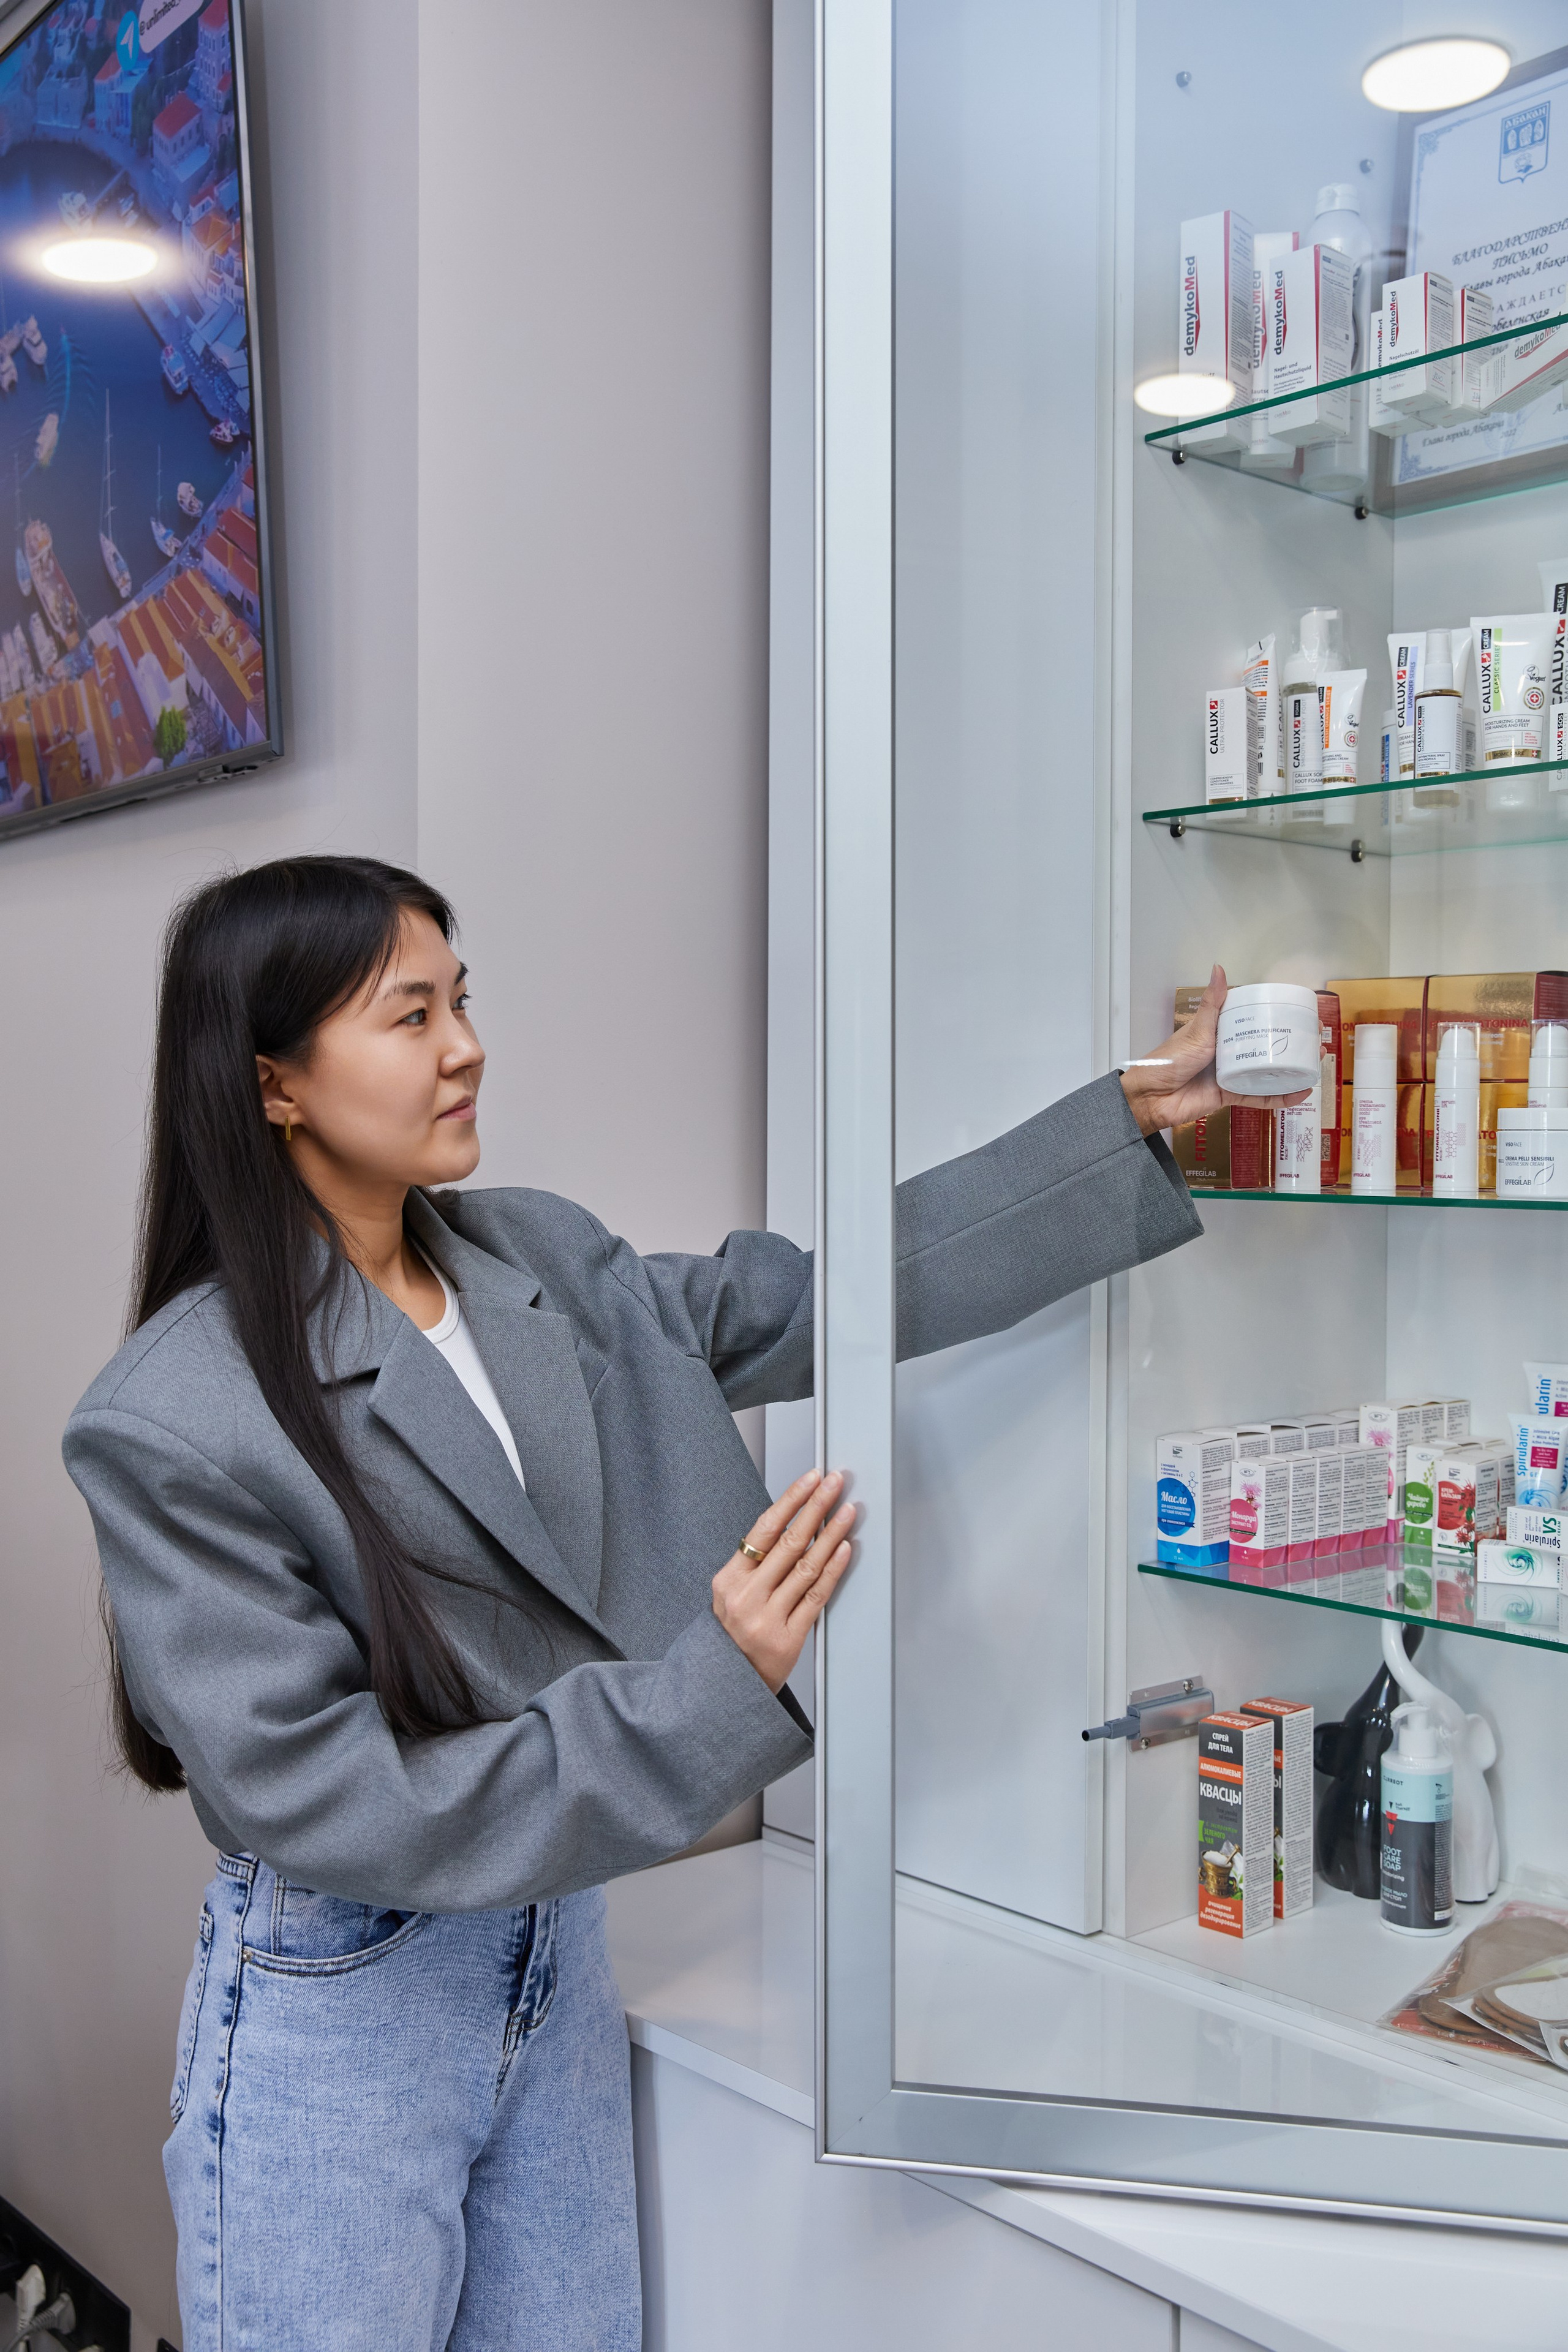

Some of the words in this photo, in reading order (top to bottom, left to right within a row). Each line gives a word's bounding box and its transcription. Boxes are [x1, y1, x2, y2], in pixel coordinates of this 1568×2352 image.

[1492, 243, 1548, 270] ПИСЬМО
[1496, 266, 1530, 284] города
[1184, 256, 1198, 356] demykoMed
[1274, 270, 1285, 355] demykoMed
[1390, 290, 1398, 347] demykoMed
[1389, 349, 1419, 361] Nagelschutzöl
[1274, 365, 1311, 380] Hautschutzliquid
[1553, 636, 1565, 704] CALLUX
[1482, 664, 1491, 714] CALLUX
[1397, 680, 1406, 728] CALLUX
[1235, 1028, 1260, 1037] MASCHERA
[1235, 1050, 1267, 1060] EFFEGILAB
[1535, 1379, 1551, 1415] ularin
[1516, 1427, 1529, 1477] Spirularin
[1161, 1491, 1188, 1505] Масло
[1231, 1510, 1256, 1523] Монарда
[1543, 1517, 1557, 1534] VS
[1525, 1534, 1561, 1548] Spirularin
[1207, 1714, 1254, 1727] КВАСЦЫ
[1212, 1732, 1229, 1743] СПРЕЙ
[1208, 1742, 1219, 1751] ДЛЯ
[1220, 1744, 1234, 1754] ТЕЛА
[1200, 1763, 1242, 1779] АЛЮМОКАЛИЕВЫЕ
[1200, 1782, 1242, 1806] КВАСЦЫ
[1204, 1828, 1226, 1839] ЗЕЛЕНОГО
[1383, 1844, 1401, 1856] FOOT
[1383, 1852, 1401, 1864] CARE
[1383, 1860, 1401, 1871] SOAP
